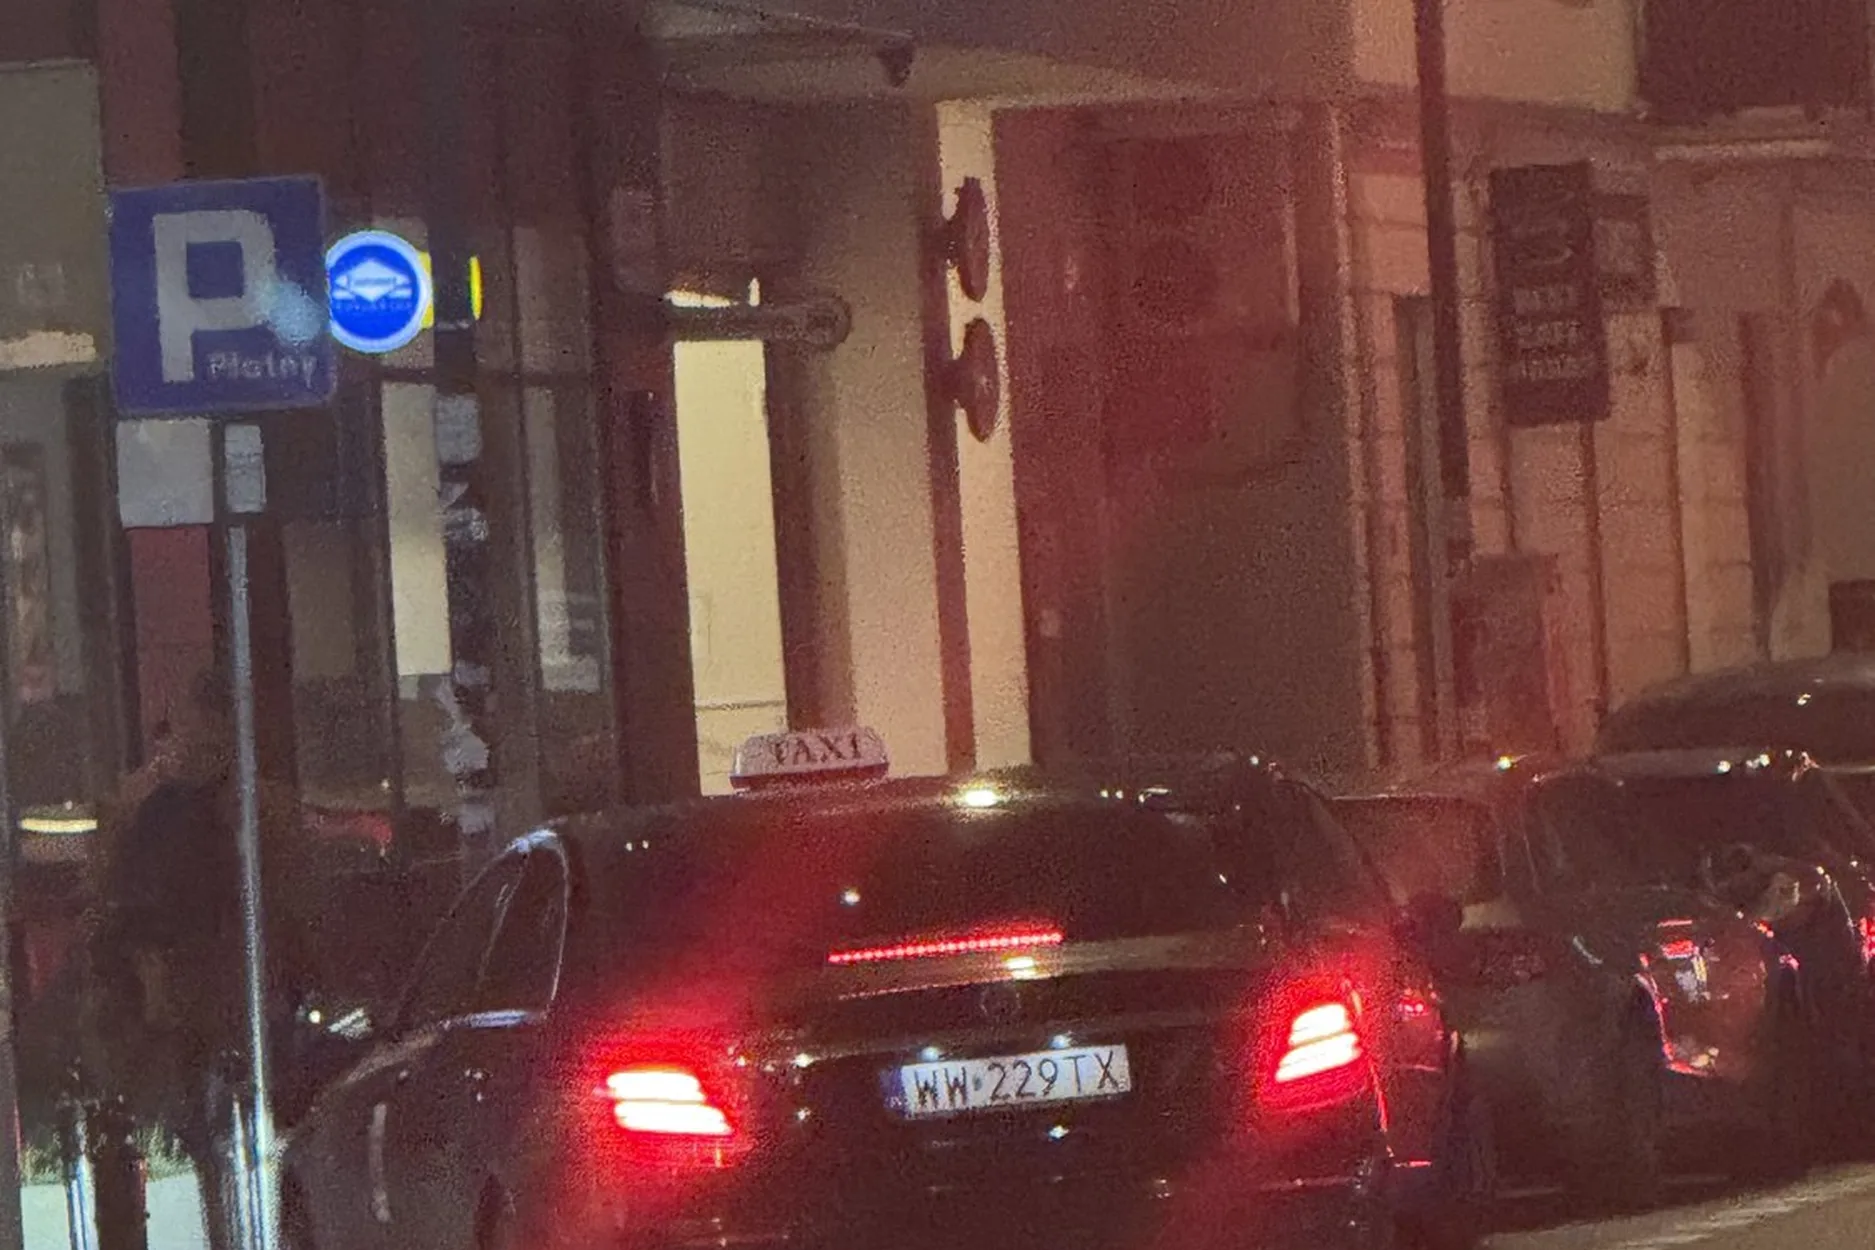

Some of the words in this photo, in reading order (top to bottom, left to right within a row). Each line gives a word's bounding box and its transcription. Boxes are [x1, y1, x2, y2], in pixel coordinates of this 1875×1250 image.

[153, 209, 276, 383] P
[767, 732, 862, 765] TAXI
[987, 1050, 1120, 1101] 229TX
